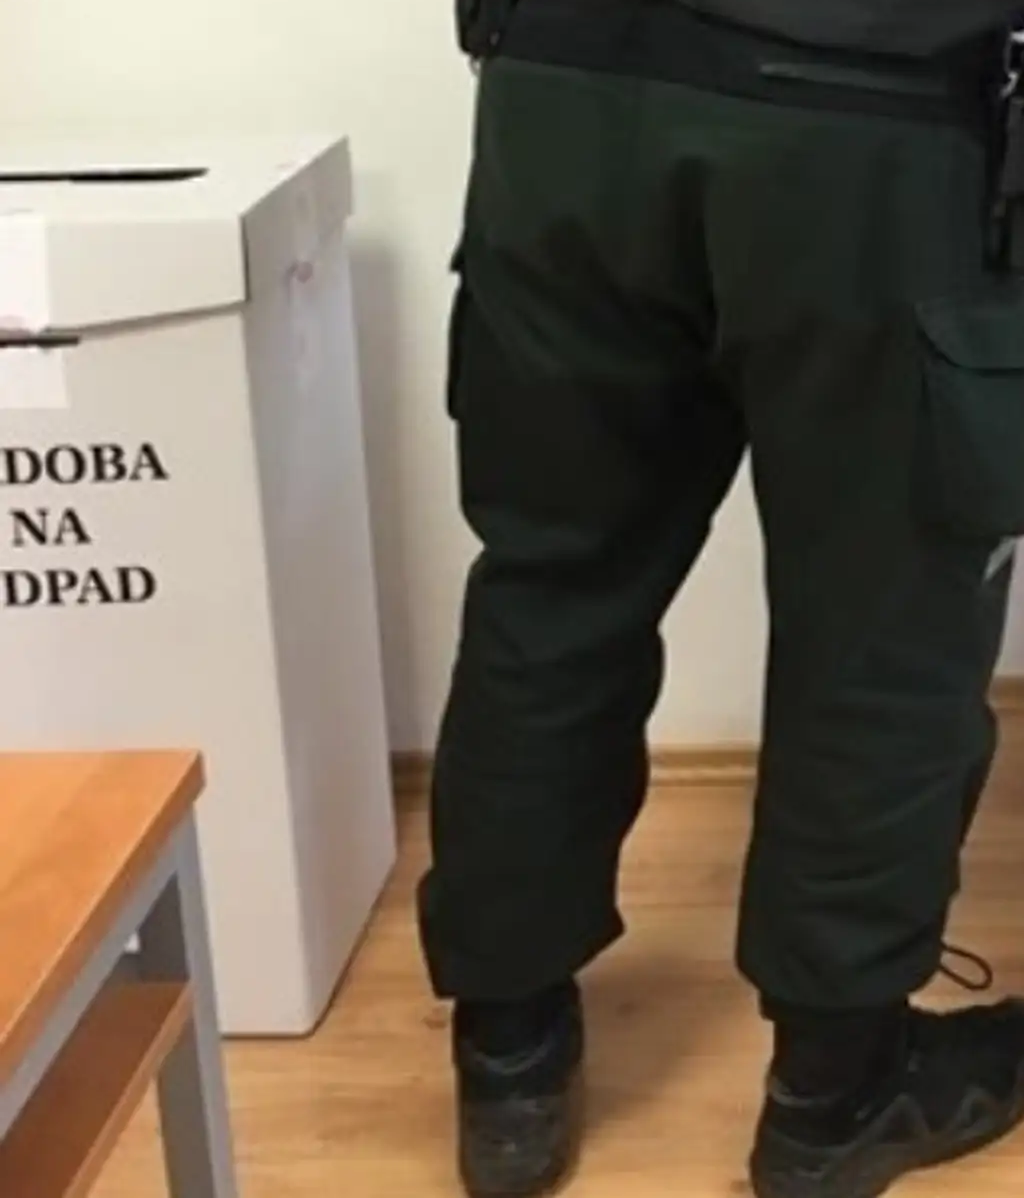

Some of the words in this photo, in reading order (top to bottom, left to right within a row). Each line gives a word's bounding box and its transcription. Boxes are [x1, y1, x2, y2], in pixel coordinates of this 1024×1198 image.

[0, 441, 170, 485] DOBA
[8, 507, 92, 547] NA
[0, 566, 157, 607] DPAD
